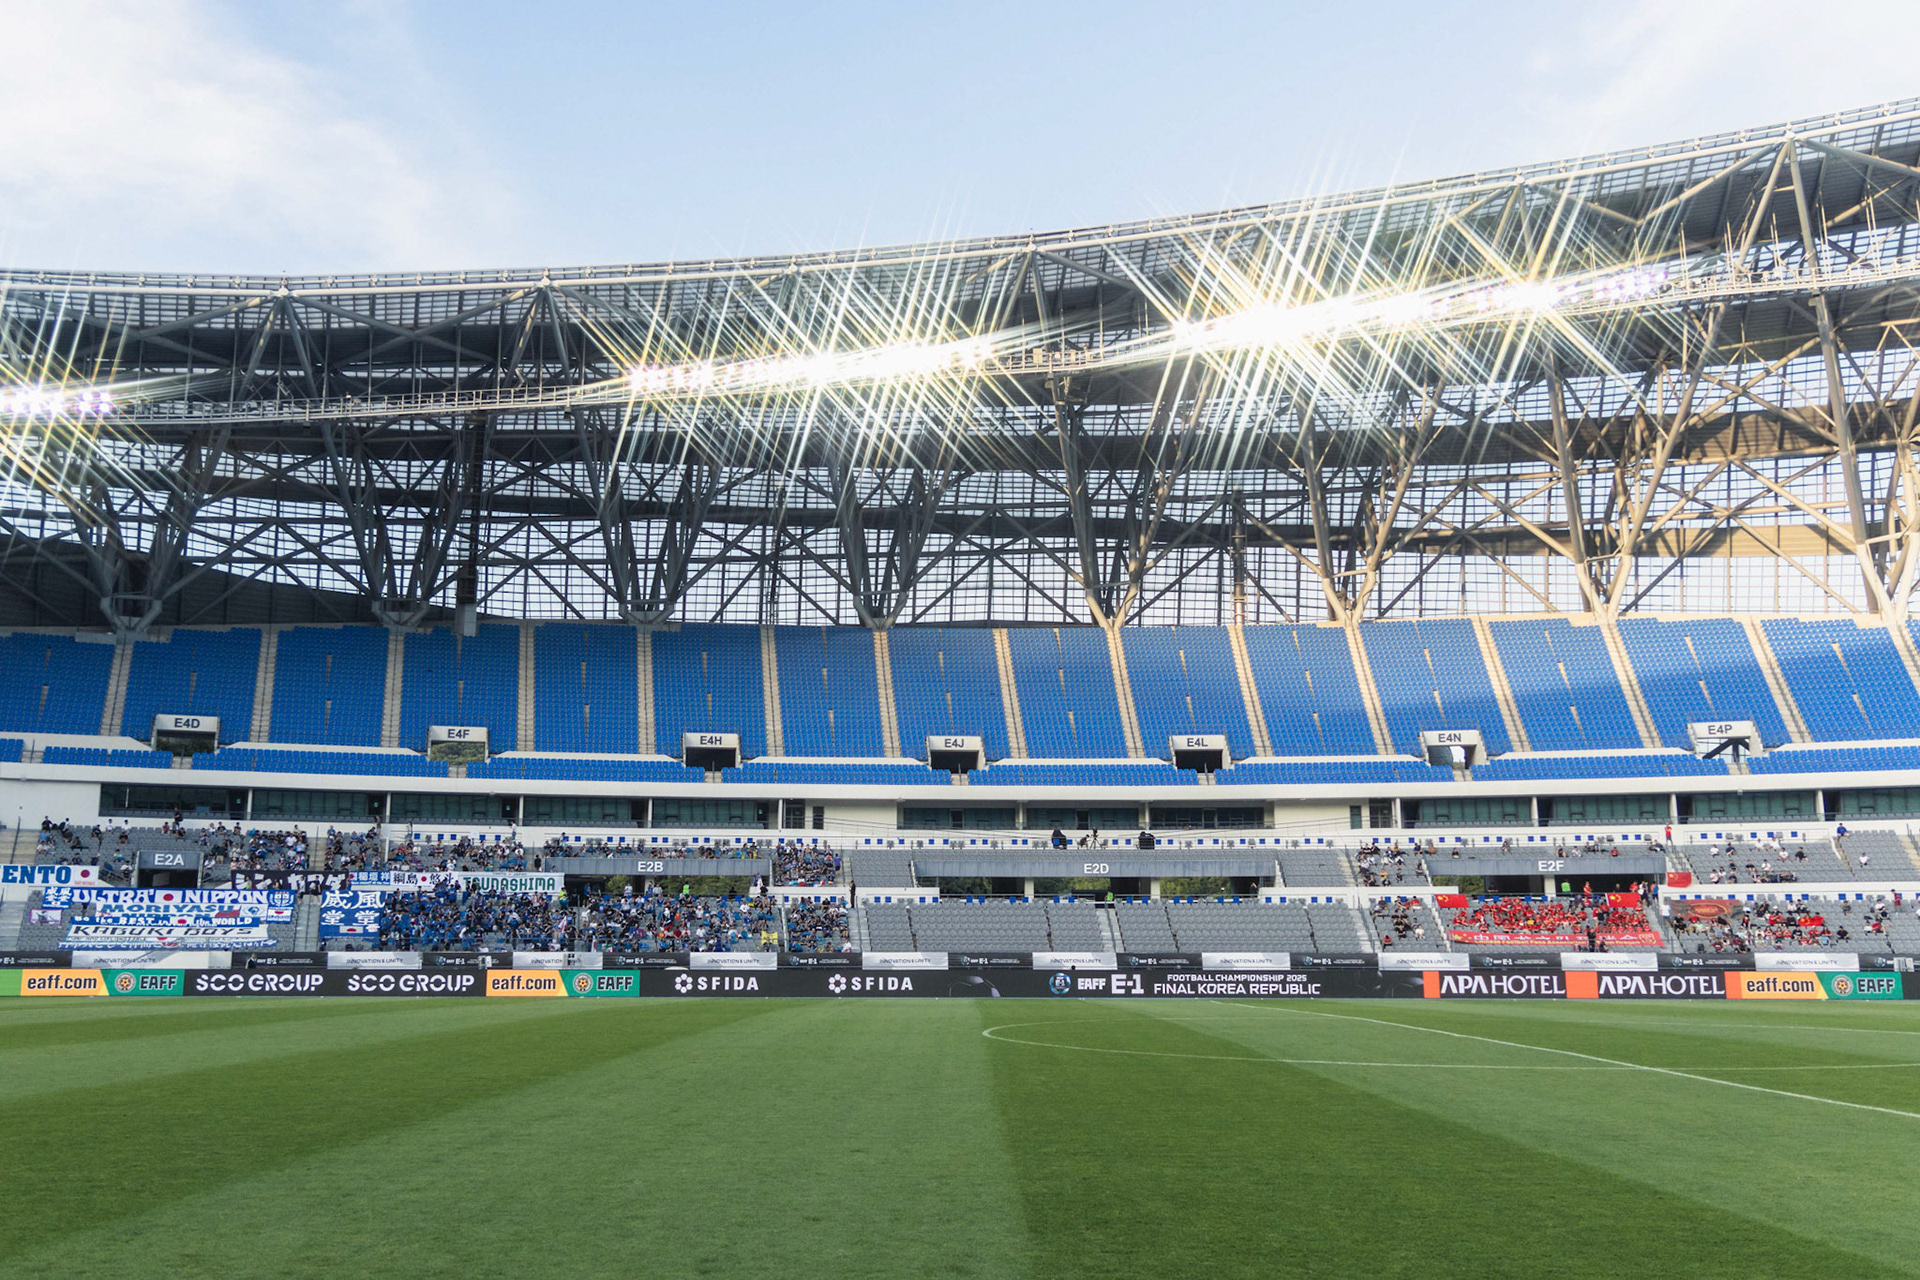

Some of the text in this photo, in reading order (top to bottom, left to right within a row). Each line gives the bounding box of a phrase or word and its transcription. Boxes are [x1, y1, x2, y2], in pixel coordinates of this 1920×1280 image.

[174, 718, 200, 729] E4D
[1708, 724, 1732, 735] E4P
[447, 728, 470, 739] E4F
[1438, 732, 1461, 744] E4N
[700, 736, 722, 746] E4H
[944, 737, 964, 748] E4J
[1187, 737, 1208, 748] E4L
[155, 854, 184, 865] E2A
[638, 862, 663, 872] E2B
[1084, 864, 1109, 873] E2D
[1538, 861, 1564, 871] E2F
[0, 865, 72, 884] ENTO
[184, 890, 269, 904] NIPPON
[101, 904, 234, 914] MORIYASU
[118, 917, 155, 925] BEST
[212, 918, 252, 926] WORLD
[73, 926, 252, 936] KABUKI BOYS
[28, 975, 96, 989] eaff.com
[140, 976, 176, 990] EAFF
[196, 974, 323, 991] SCO GROUP
[348, 975, 474, 991] SCO GROUP
[492, 975, 556, 989] eaff.com
[597, 976, 632, 990] EAFF
[698, 977, 758, 990] SFIDA
[851, 977, 913, 990] SFIDA
[1078, 974, 1144, 994] EAFF E-1
[1168, 974, 1307, 982] FOOTBALL CHAMPIONSHIP 2025
[1154, 984, 1320, 994] FINAL KOREA REPUBLIC
[1441, 976, 1566, 994] APA HOTEL
[1599, 976, 1724, 994] APA HOTEL
[1747, 978, 1814, 992] eaff.com
[1858, 979, 1894, 993] EAFF
